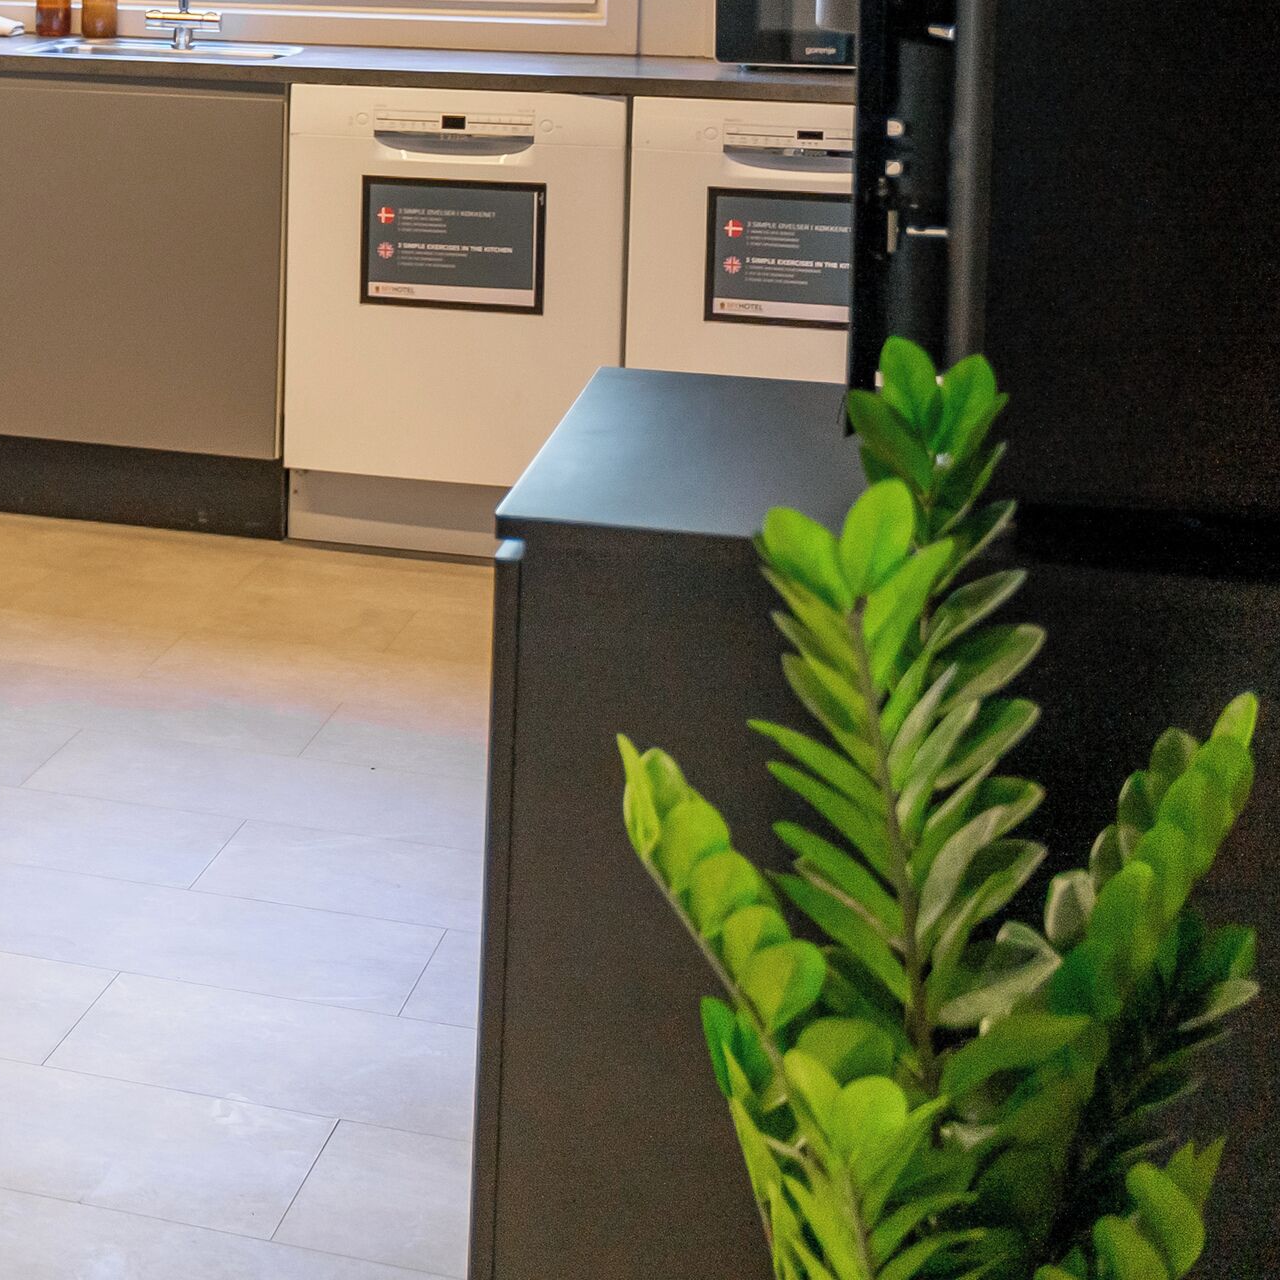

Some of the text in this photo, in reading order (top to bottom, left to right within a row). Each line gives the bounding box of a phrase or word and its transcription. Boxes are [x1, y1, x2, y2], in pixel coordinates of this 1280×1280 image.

[752, 221, 777, 229] SIMPLE
[403, 242, 426, 250] SIMPLE
[426, 243, 460, 252] EXERCISES
[483, 246, 513, 254] KITCHEN
[751, 257, 776, 265] SIMPLE
[777, 259, 814, 268] EXERCISES
[814, 260, 823, 268] IN
[824, 261, 838, 269] THE
